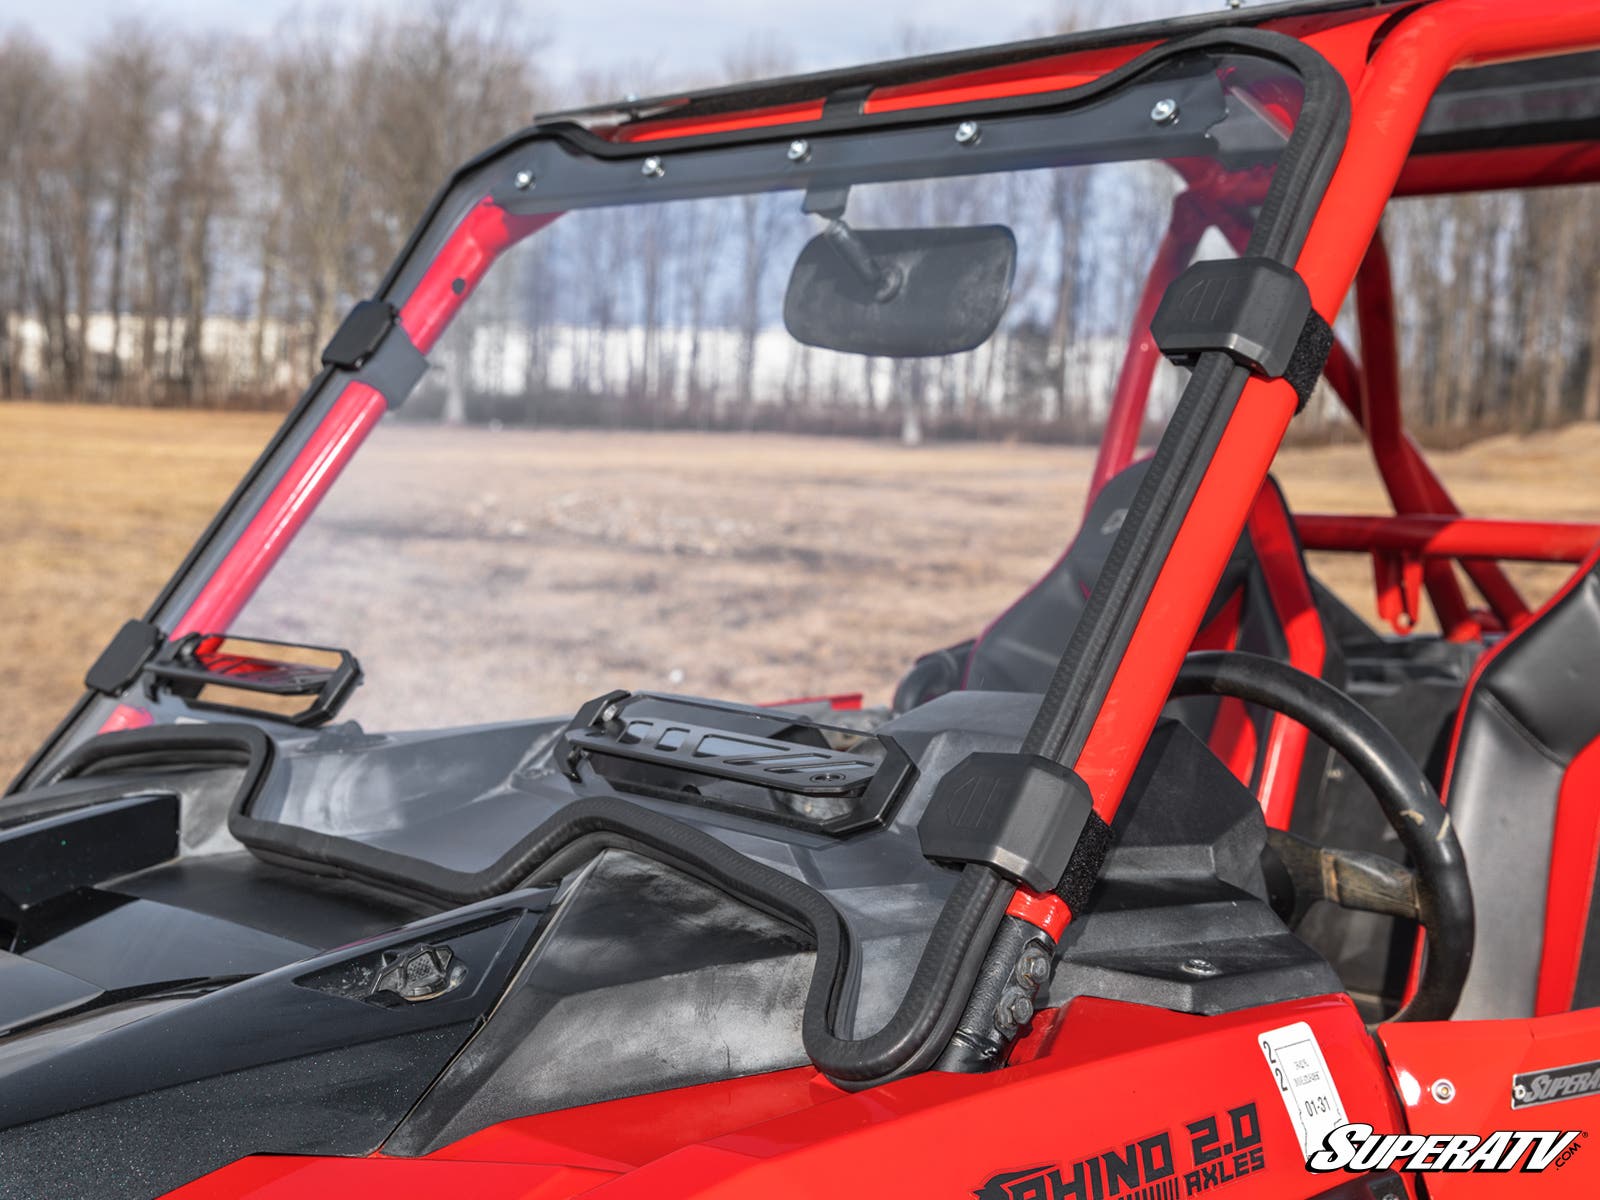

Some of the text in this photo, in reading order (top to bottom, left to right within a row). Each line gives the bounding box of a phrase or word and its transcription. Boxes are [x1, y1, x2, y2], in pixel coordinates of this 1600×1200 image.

[1304, 1096, 1332, 1118] 01-31
[1186, 1102, 1262, 1166] 2.0
[1184, 1147, 1266, 1196] AXLES
